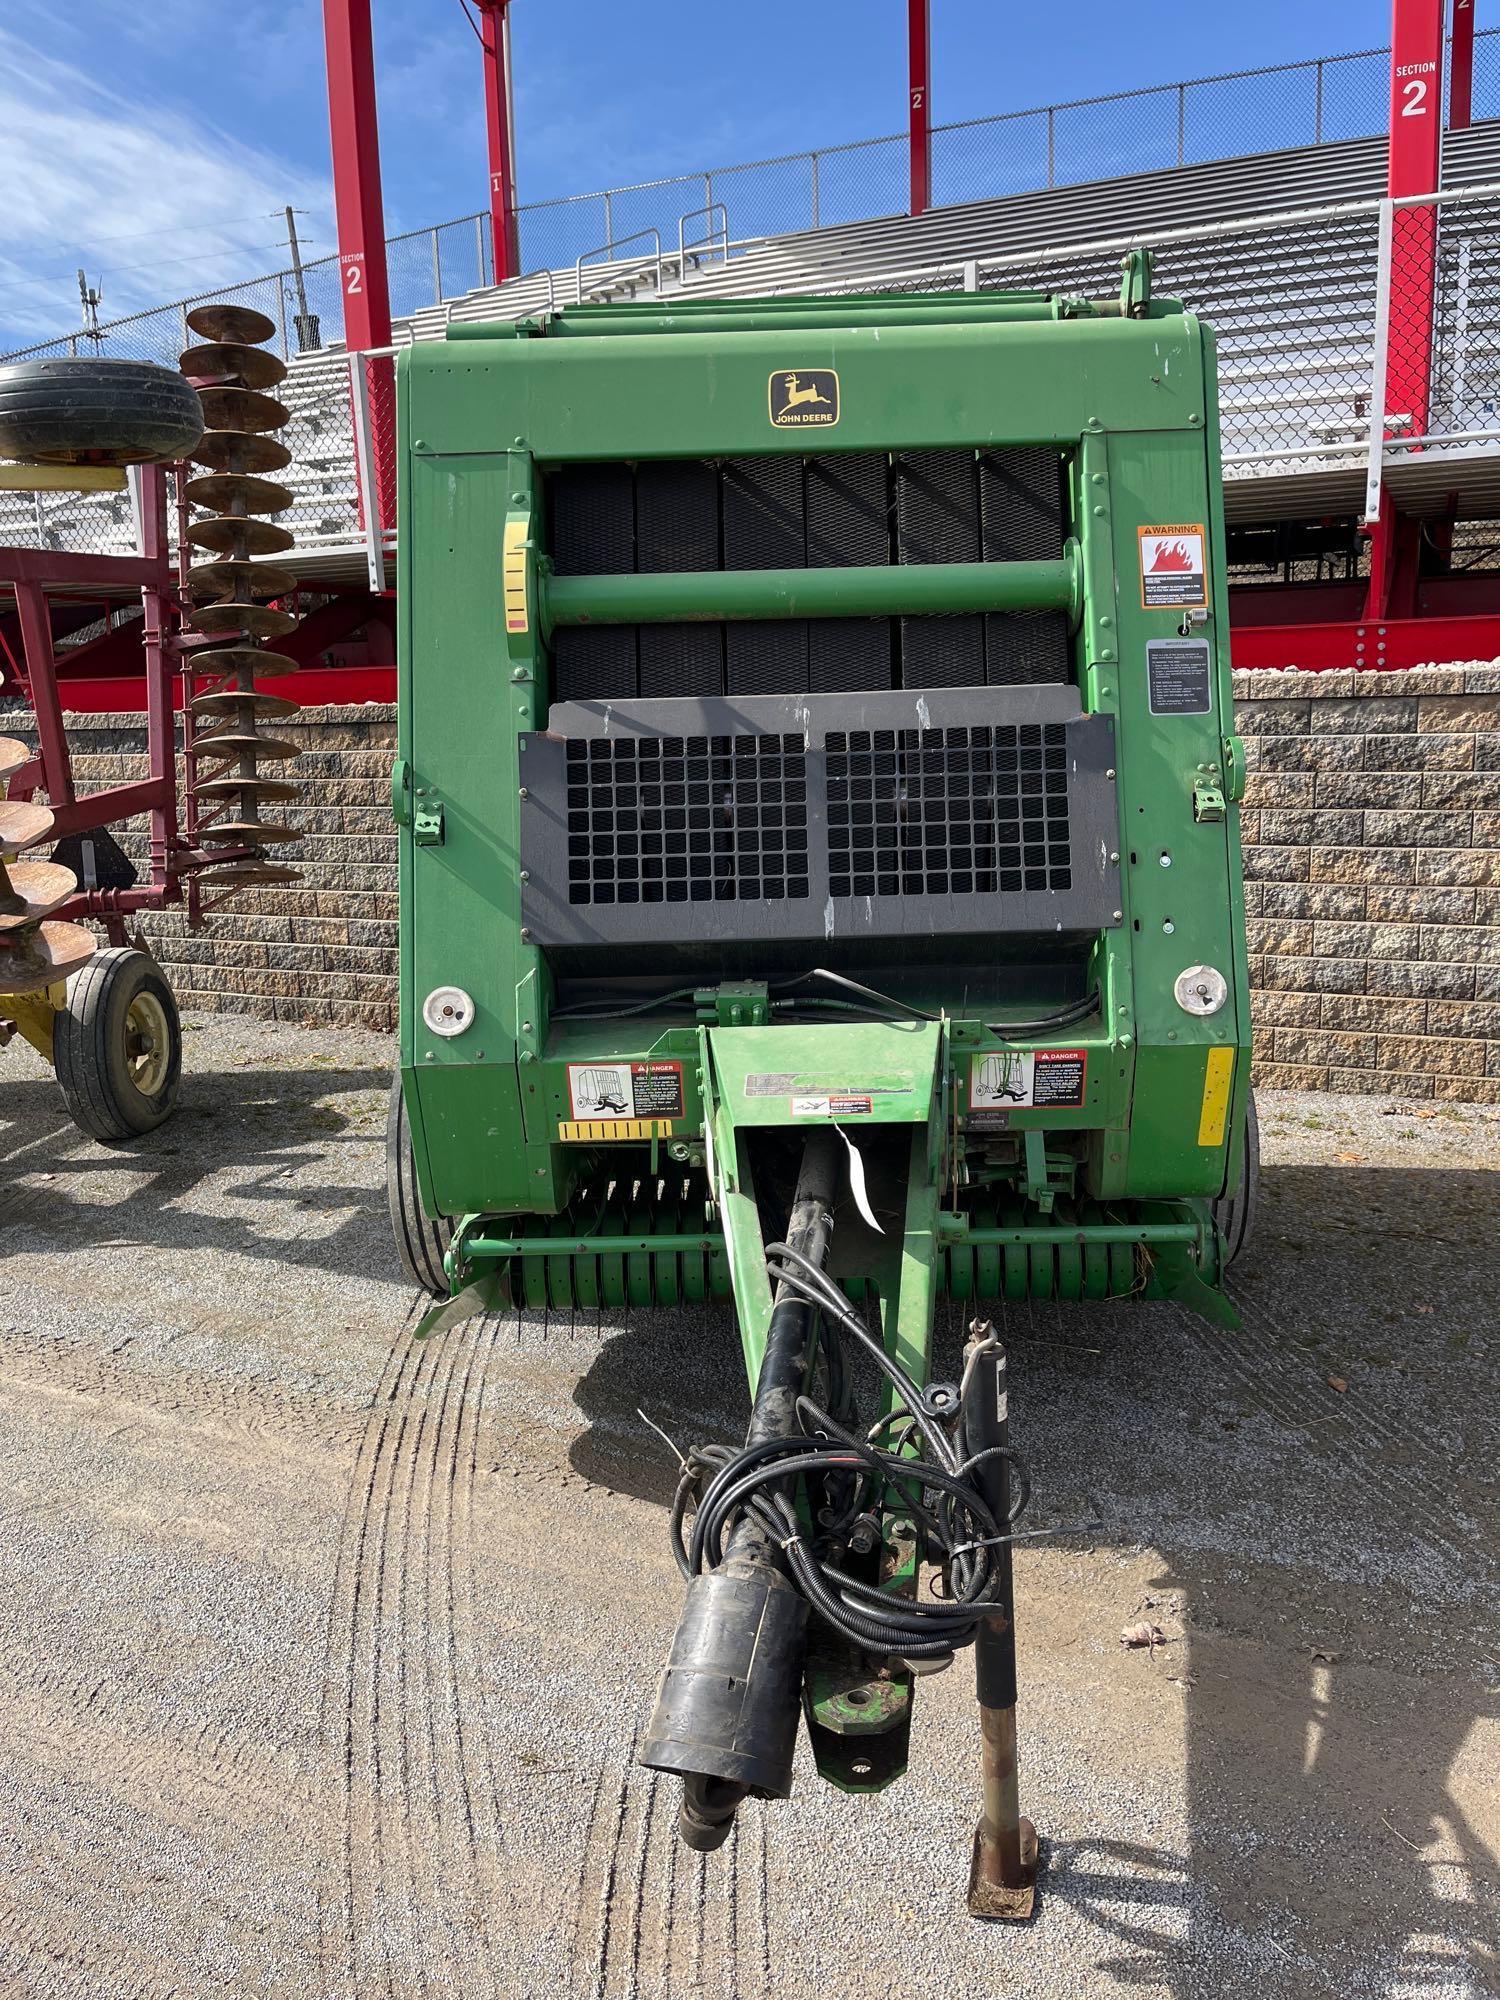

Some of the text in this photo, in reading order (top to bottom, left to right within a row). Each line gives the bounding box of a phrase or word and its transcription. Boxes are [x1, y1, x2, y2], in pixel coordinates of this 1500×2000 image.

[1396, 61, 1436, 77] SECTION
[912, 93, 922, 109] 2
[1402, 80, 1427, 117] 2
[493, 178, 500, 192] 1
[341, 252, 365, 264] SECTION
[346, 266, 362, 294] 2
[776, 413, 833, 423] JOHN DEERE
[1152, 525, 1198, 534] WARNING
